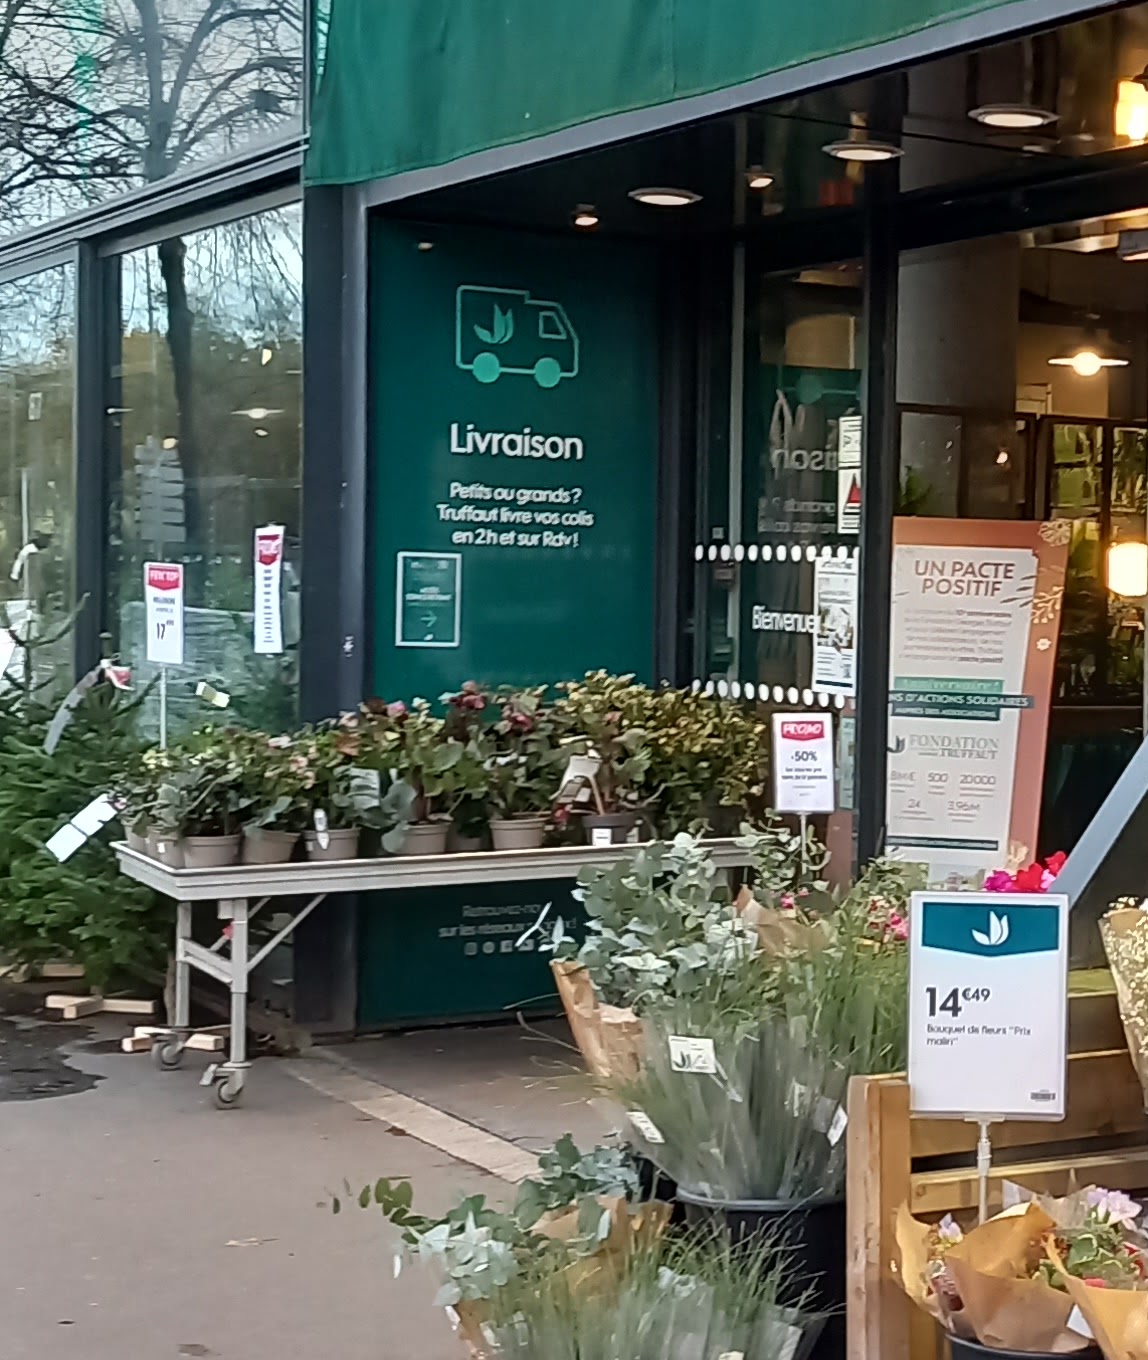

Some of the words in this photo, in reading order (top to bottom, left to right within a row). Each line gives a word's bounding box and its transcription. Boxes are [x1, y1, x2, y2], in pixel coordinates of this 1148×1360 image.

[450, 423, 583, 460] Livraison
[450, 482, 492, 500] Petits
[494, 488, 515, 501] ou
[436, 504, 498, 523] Truffaut
[500, 506, 532, 524] livre
[534, 511, 560, 525] vos
[561, 509, 594, 526] colis
[452, 530, 473, 544] en
[499, 530, 516, 546] et
[517, 533, 541, 547] sur
[915, 560, 945, 577] UN
[951, 561, 1015, 580] PACTE
[921, 578, 1003, 597] POSITIF
[752, 605, 815, 633] Bienvenue
[909, 734, 1000, 751] FONDATION
[939, 748, 999, 760] TRUFFAUT
[925, 986, 992, 1018] 14€49
[926, 1023, 965, 1036] Bouquet
[967, 1024, 979, 1035] de
[981, 1025, 1006, 1035] fleurs
